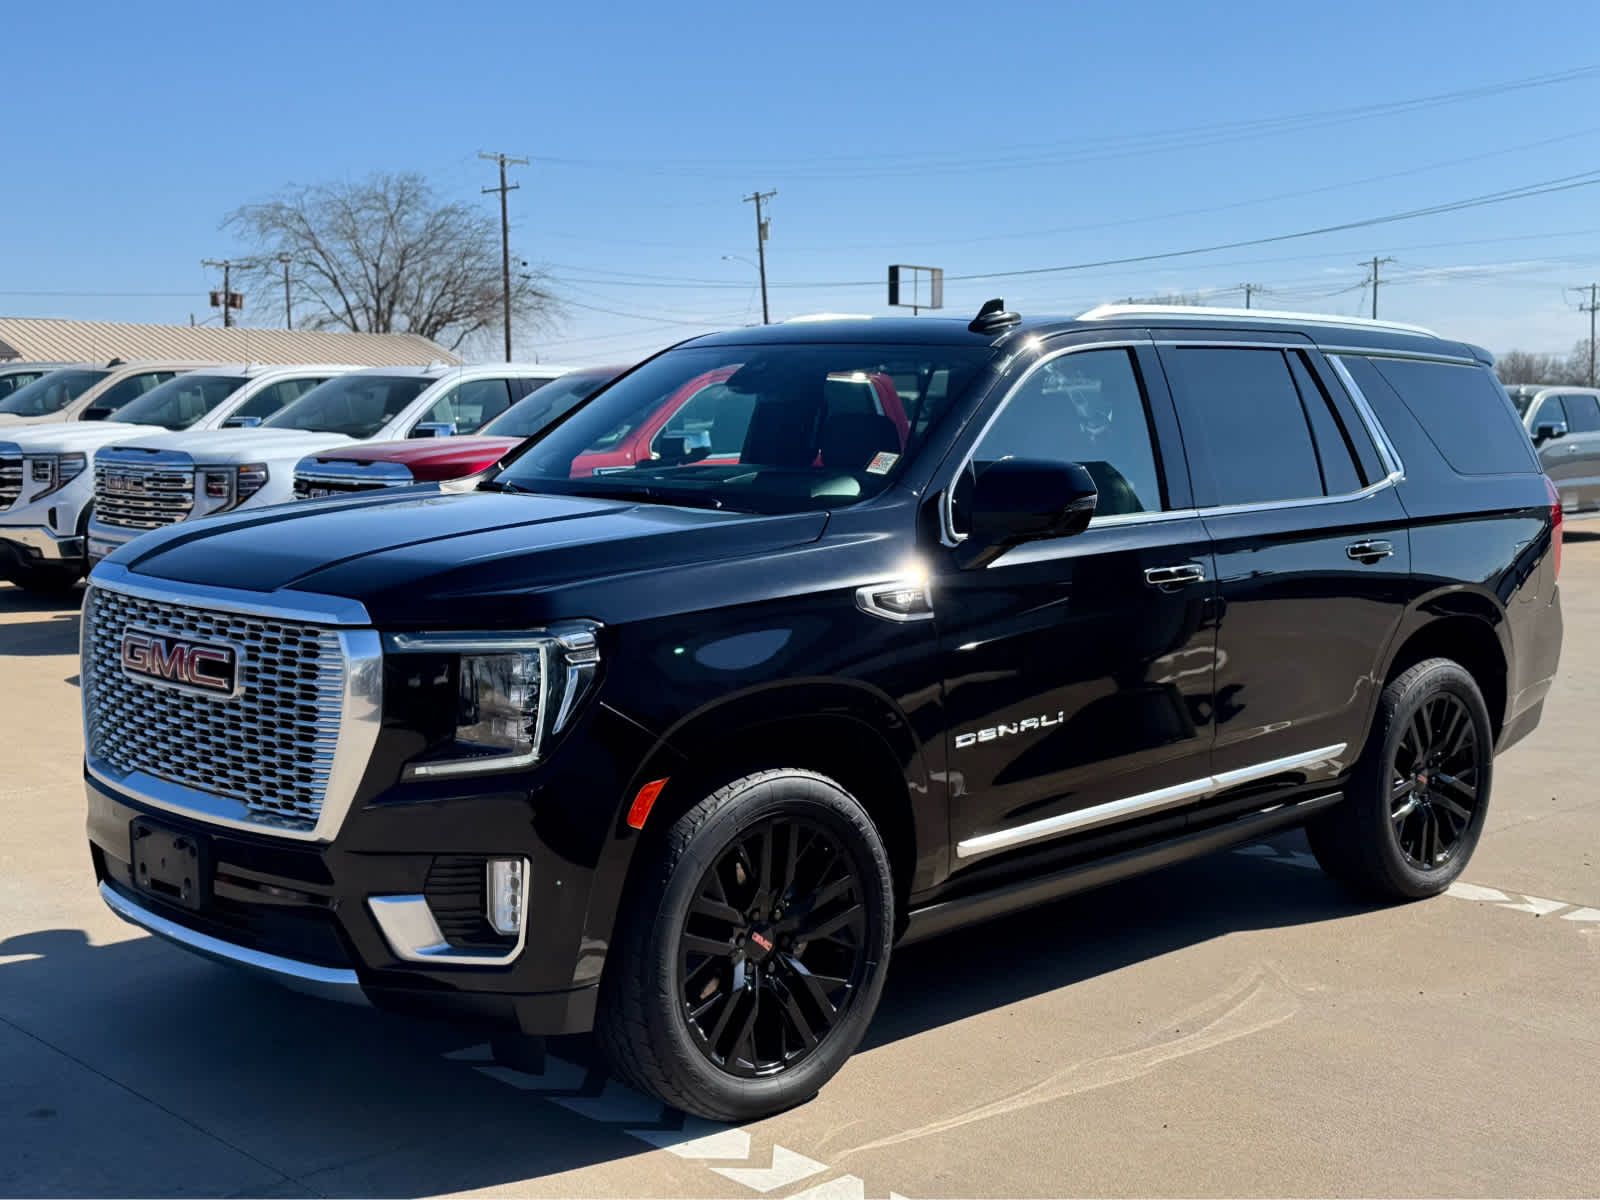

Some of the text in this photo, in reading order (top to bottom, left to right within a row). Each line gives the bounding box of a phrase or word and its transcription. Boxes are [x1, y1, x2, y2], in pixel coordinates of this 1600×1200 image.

[107, 475, 143, 491] GMC
[121, 632, 228, 689] GMC
[955, 711, 1064, 748] DENALI
